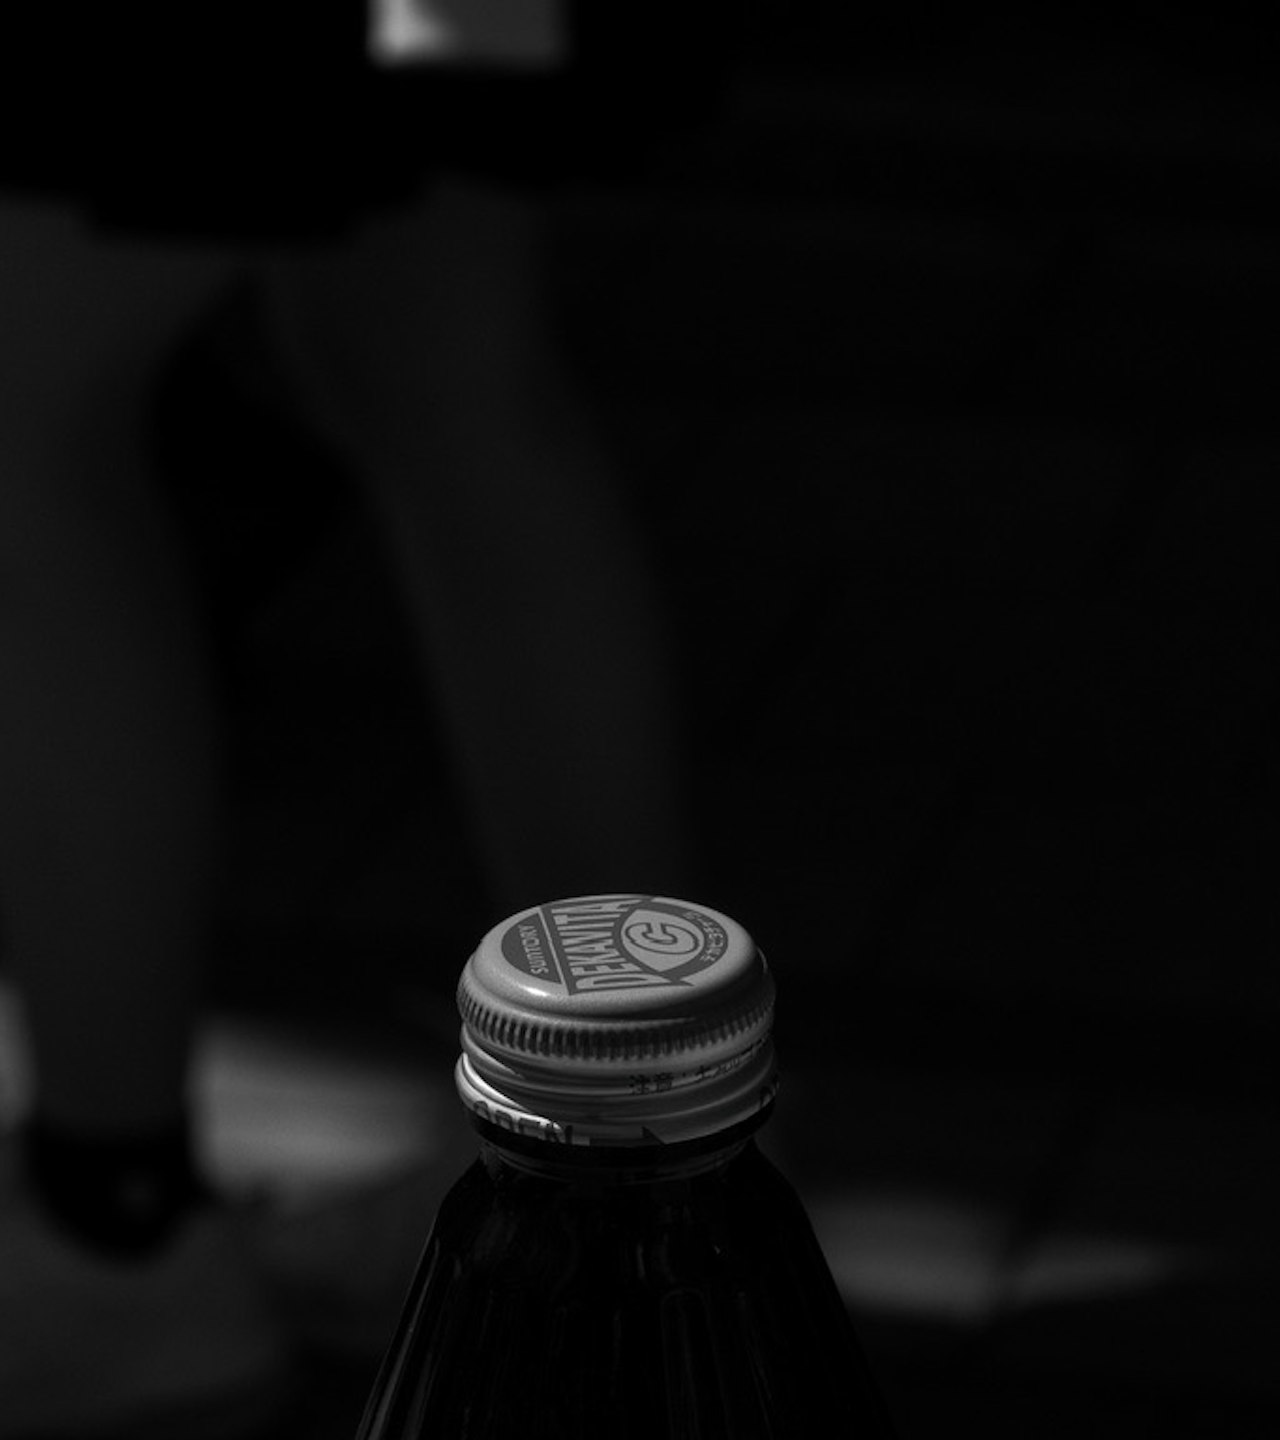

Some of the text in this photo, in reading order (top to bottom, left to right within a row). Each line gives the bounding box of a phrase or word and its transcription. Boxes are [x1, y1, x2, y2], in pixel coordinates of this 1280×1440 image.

[518, 923, 549, 975] SUNTORY
[551, 898, 672, 992] DEKAVITA
[625, 921, 699, 955] C
